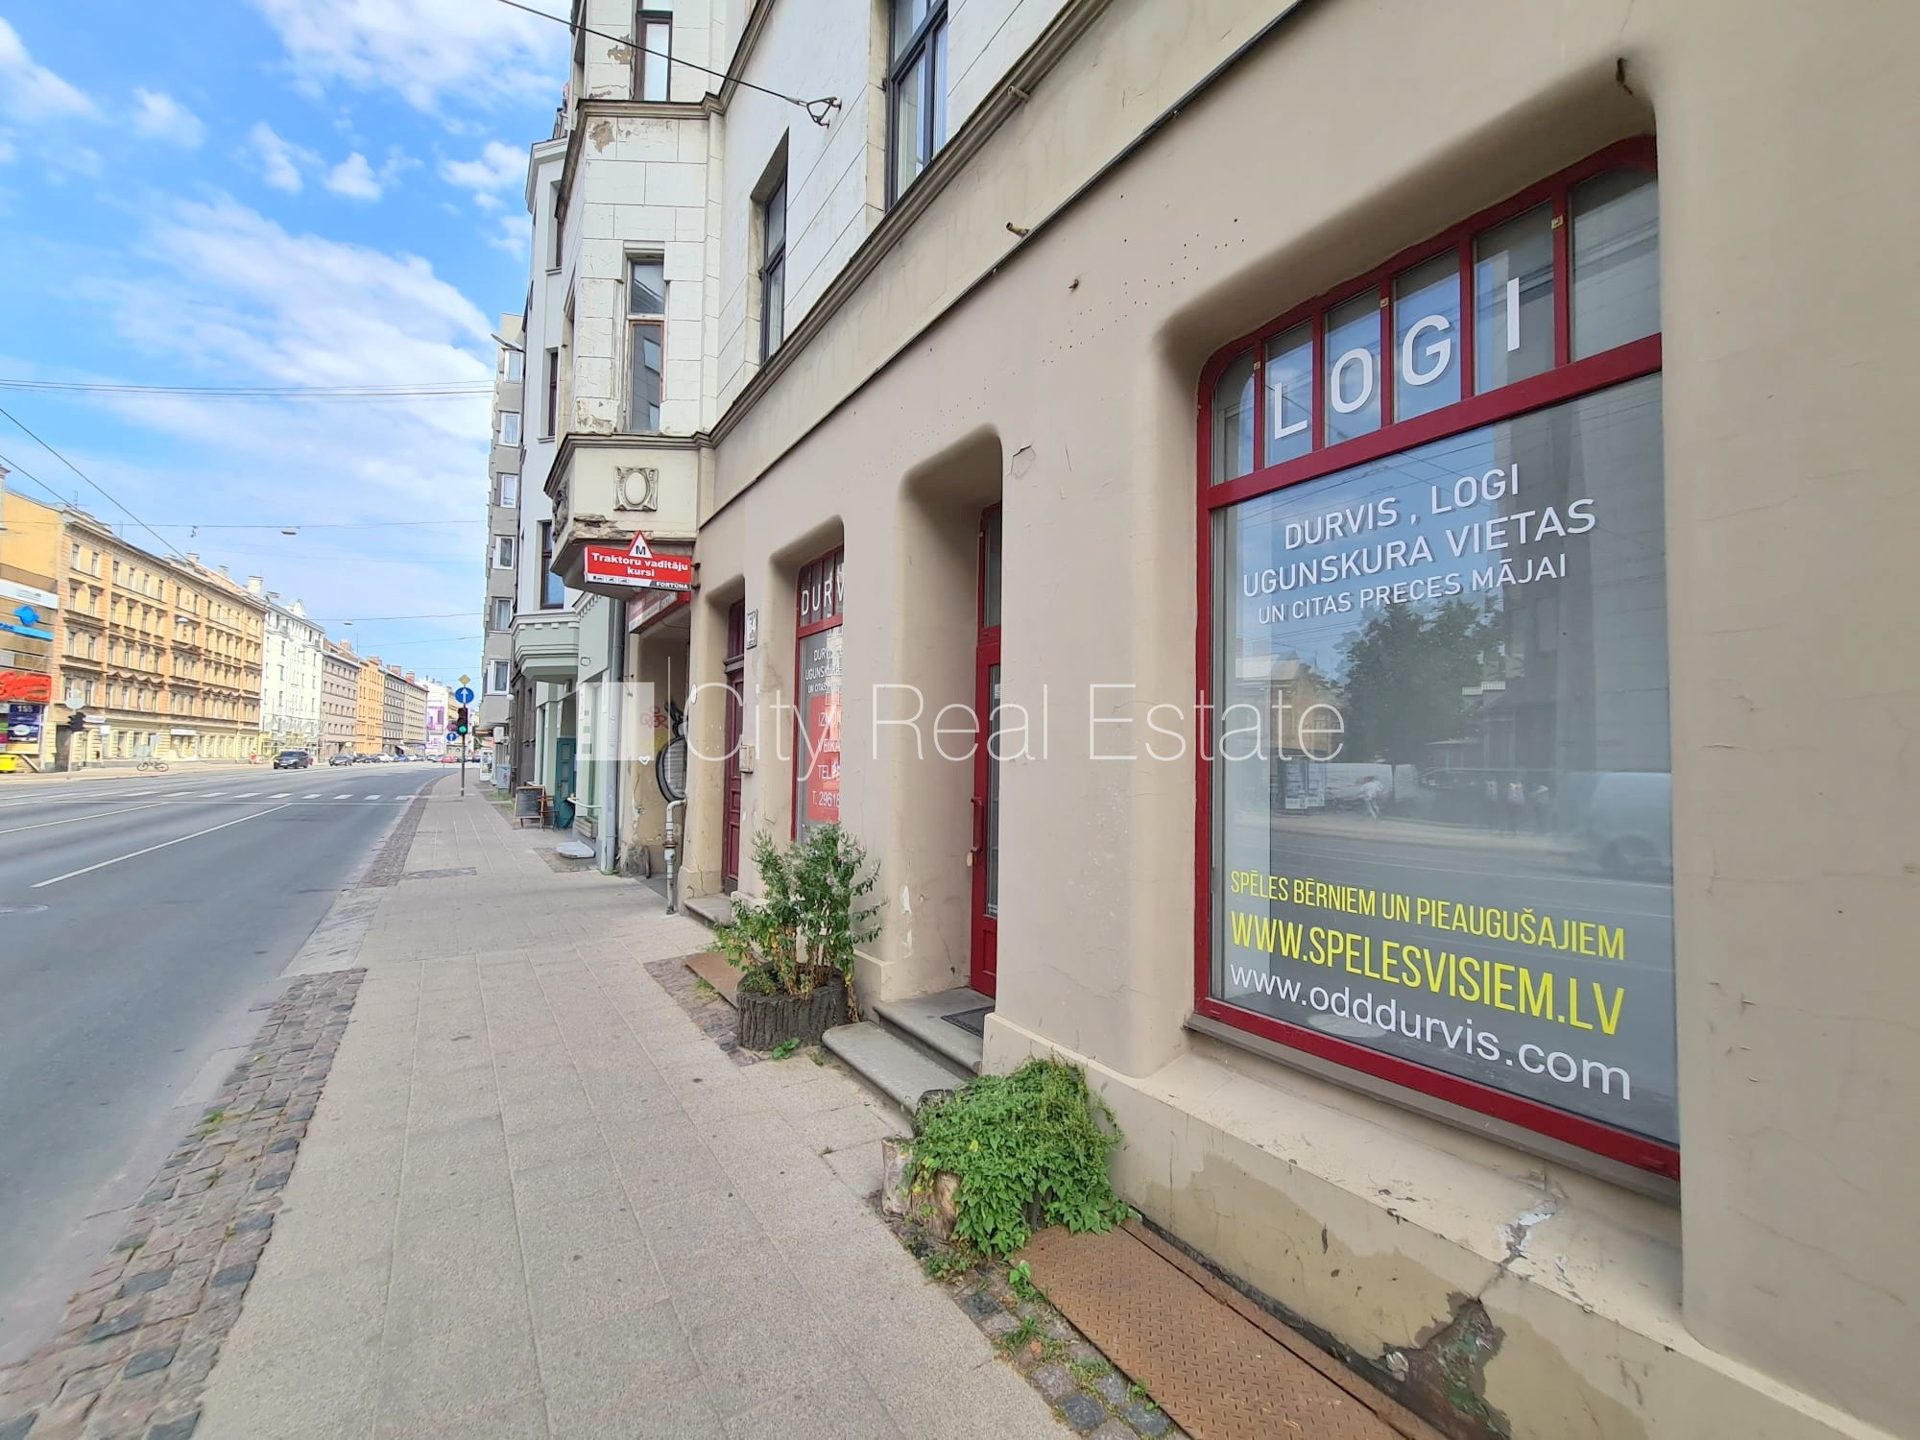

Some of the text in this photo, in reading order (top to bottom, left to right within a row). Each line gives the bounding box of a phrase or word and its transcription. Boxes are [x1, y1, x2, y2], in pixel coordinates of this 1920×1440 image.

[1273, 276, 1520, 440] LOGI
[1431, 463, 1520, 515] LOGI
[592, 552, 642, 567] Traktoru
[627, 566, 655, 577] kursi
[635, 545, 646, 556] M
[1242, 498, 1597, 598] UGUNSKURA VIETAS
[1258, 552, 1567, 625] UN CITAS PRECES MĀJAI
[1230, 869, 1626, 961] SPĒLES BĒRNIEM UN PIEAUGUŠAJIEM
[1230, 909, 1626, 1037] WWW.SPELESVISIEM.LV
[1229, 962, 1633, 1101] www.odddurvis.com
